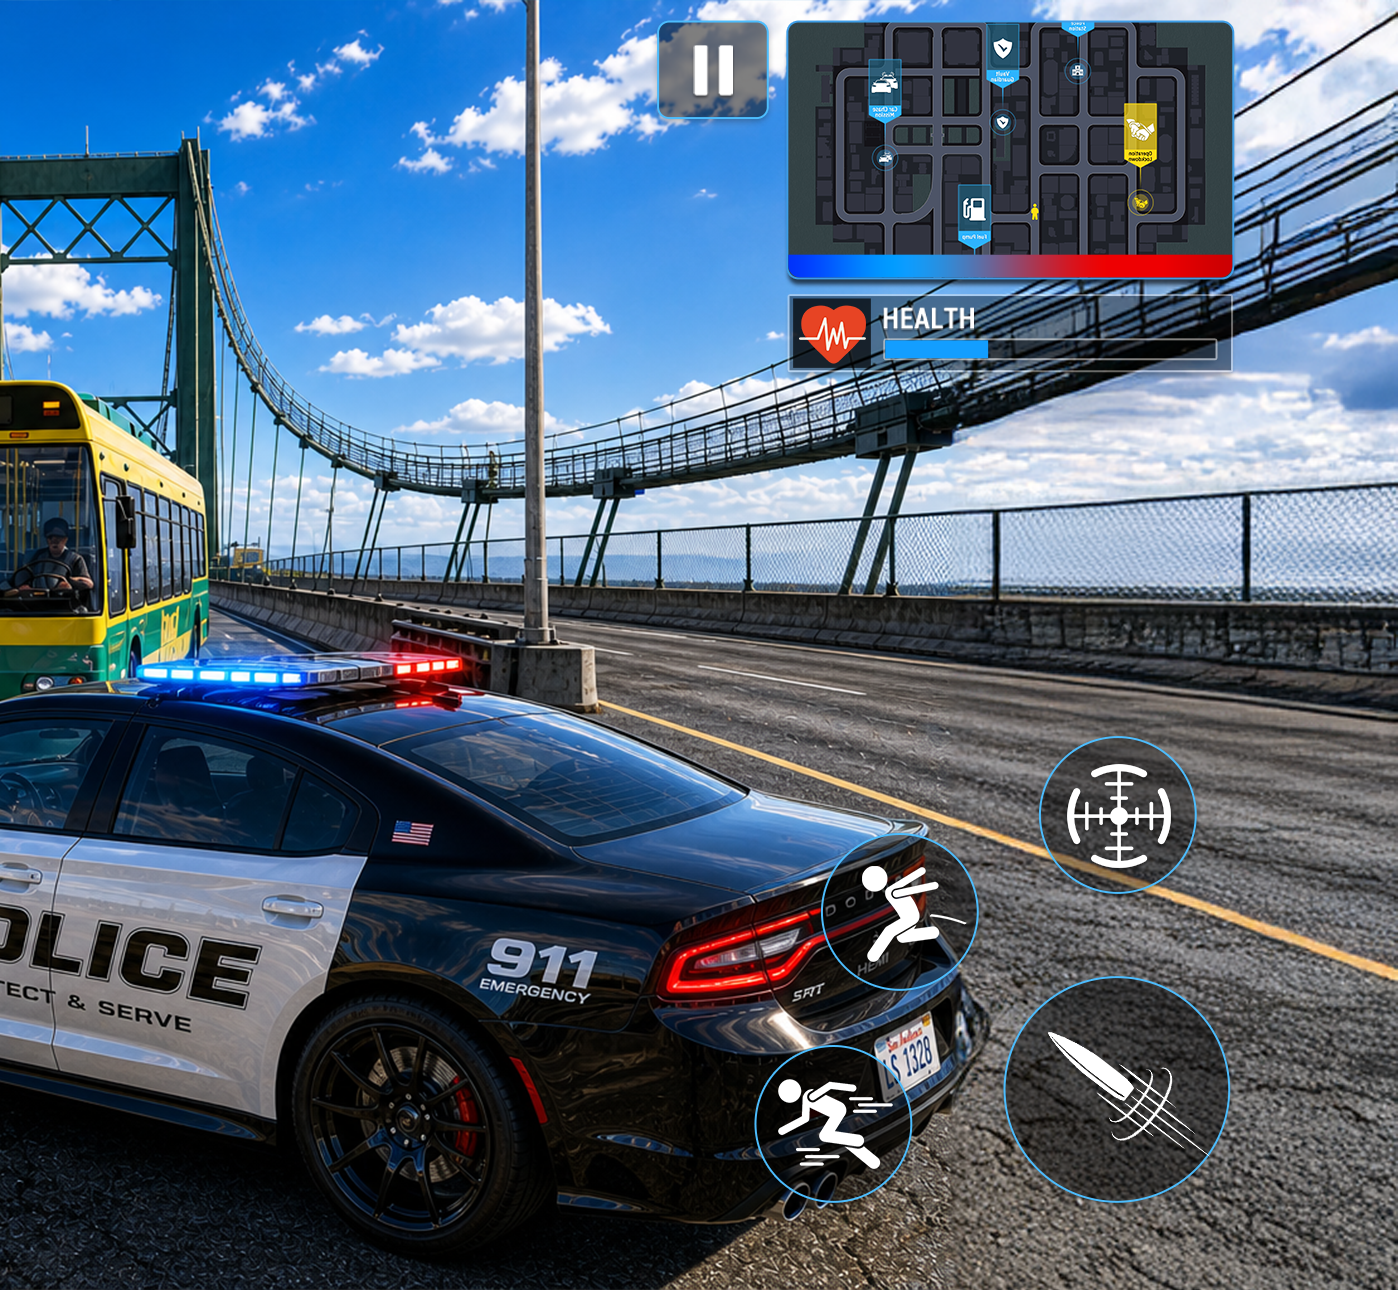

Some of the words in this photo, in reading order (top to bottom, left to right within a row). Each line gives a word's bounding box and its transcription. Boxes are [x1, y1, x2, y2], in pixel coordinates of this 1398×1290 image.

[487, 937, 598, 989] 911
[67, 993, 86, 1012] &
[98, 999, 192, 1034] SERVE
[479, 977, 591, 1004] EMERGENCY
[883, 1053, 901, 1090] LS
[903, 1035, 933, 1077] 1328
